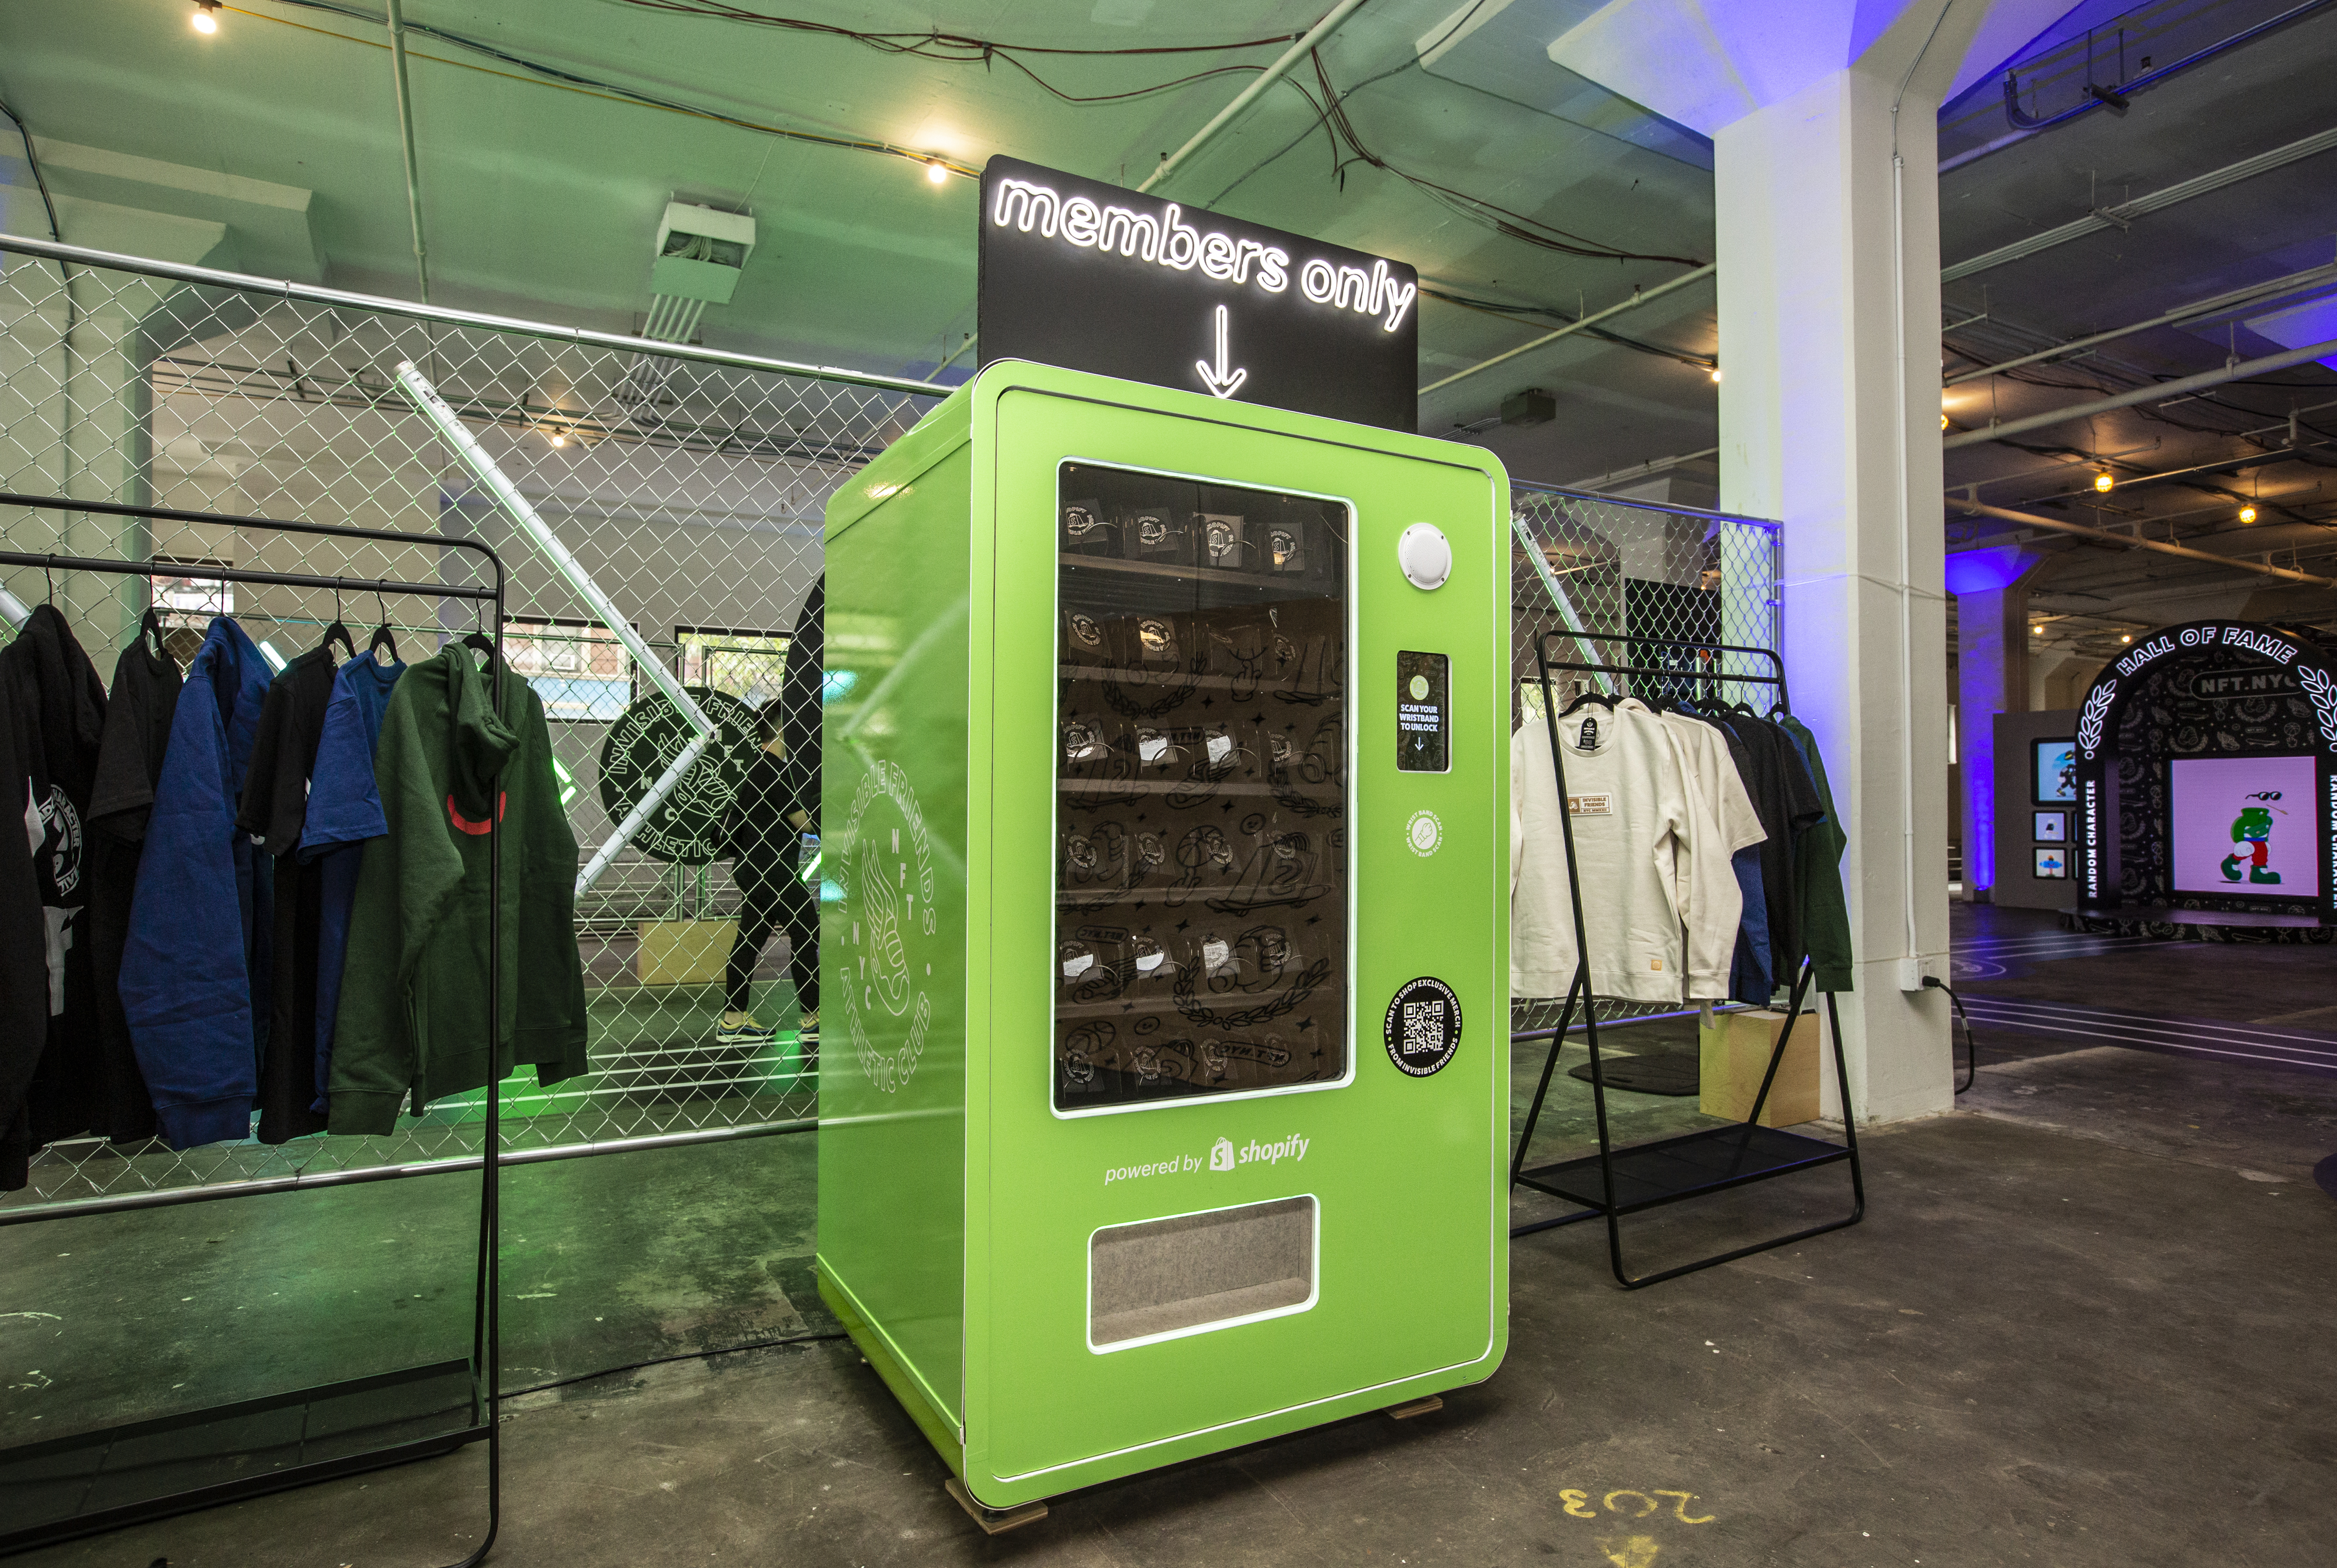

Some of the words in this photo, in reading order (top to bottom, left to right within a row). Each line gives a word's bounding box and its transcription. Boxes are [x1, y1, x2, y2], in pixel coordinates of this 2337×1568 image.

[994, 178, 1288, 292] members
[1301, 259, 1416, 332] only
[2116, 636, 2175, 676] HALL
[2180, 627, 2216, 646] OF
[2222, 627, 2297, 664] FAME
[1399, 713, 1439, 723] WRISTBAND
[1400, 704, 1419, 713] SCAN
[1419, 705, 1438, 713] YOUR
[1411, 723, 1438, 731] UNLOCK
[1406, 812, 1419, 830] WRIST
[1433, 814, 1443, 831] SCAN
[2085, 780, 2097, 846] CHARACTER
[838, 759, 886, 913] INVISIBLE
[889, 762, 936, 936] FRIENDS
[1406, 837, 1419, 855] WRIST
[1433, 837, 1443, 853] SCAN
[2086, 849, 2097, 898] RANDOM
[840, 967, 894, 1094] ATHLETIC
[897, 991, 930, 1085] CLUB
[1386, 1010, 1395, 1035] SCAN
[1391, 997, 1400, 1010] TO
[1399, 981, 1417, 999] SHOP
[1417, 979, 1453, 999] EXCLUSIVE
[1450, 997, 1461, 1028] MERCH
[1388, 1043, 1404, 1067] FROM
[1402, 1064, 1436, 1075] INVISIBLE
[1436, 1037, 1458, 1069] FRIENDS
[1104, 1155, 1180, 1185] powered
[1183, 1154, 1203, 1173] by
[1238, 1133, 1310, 1165] shopify
